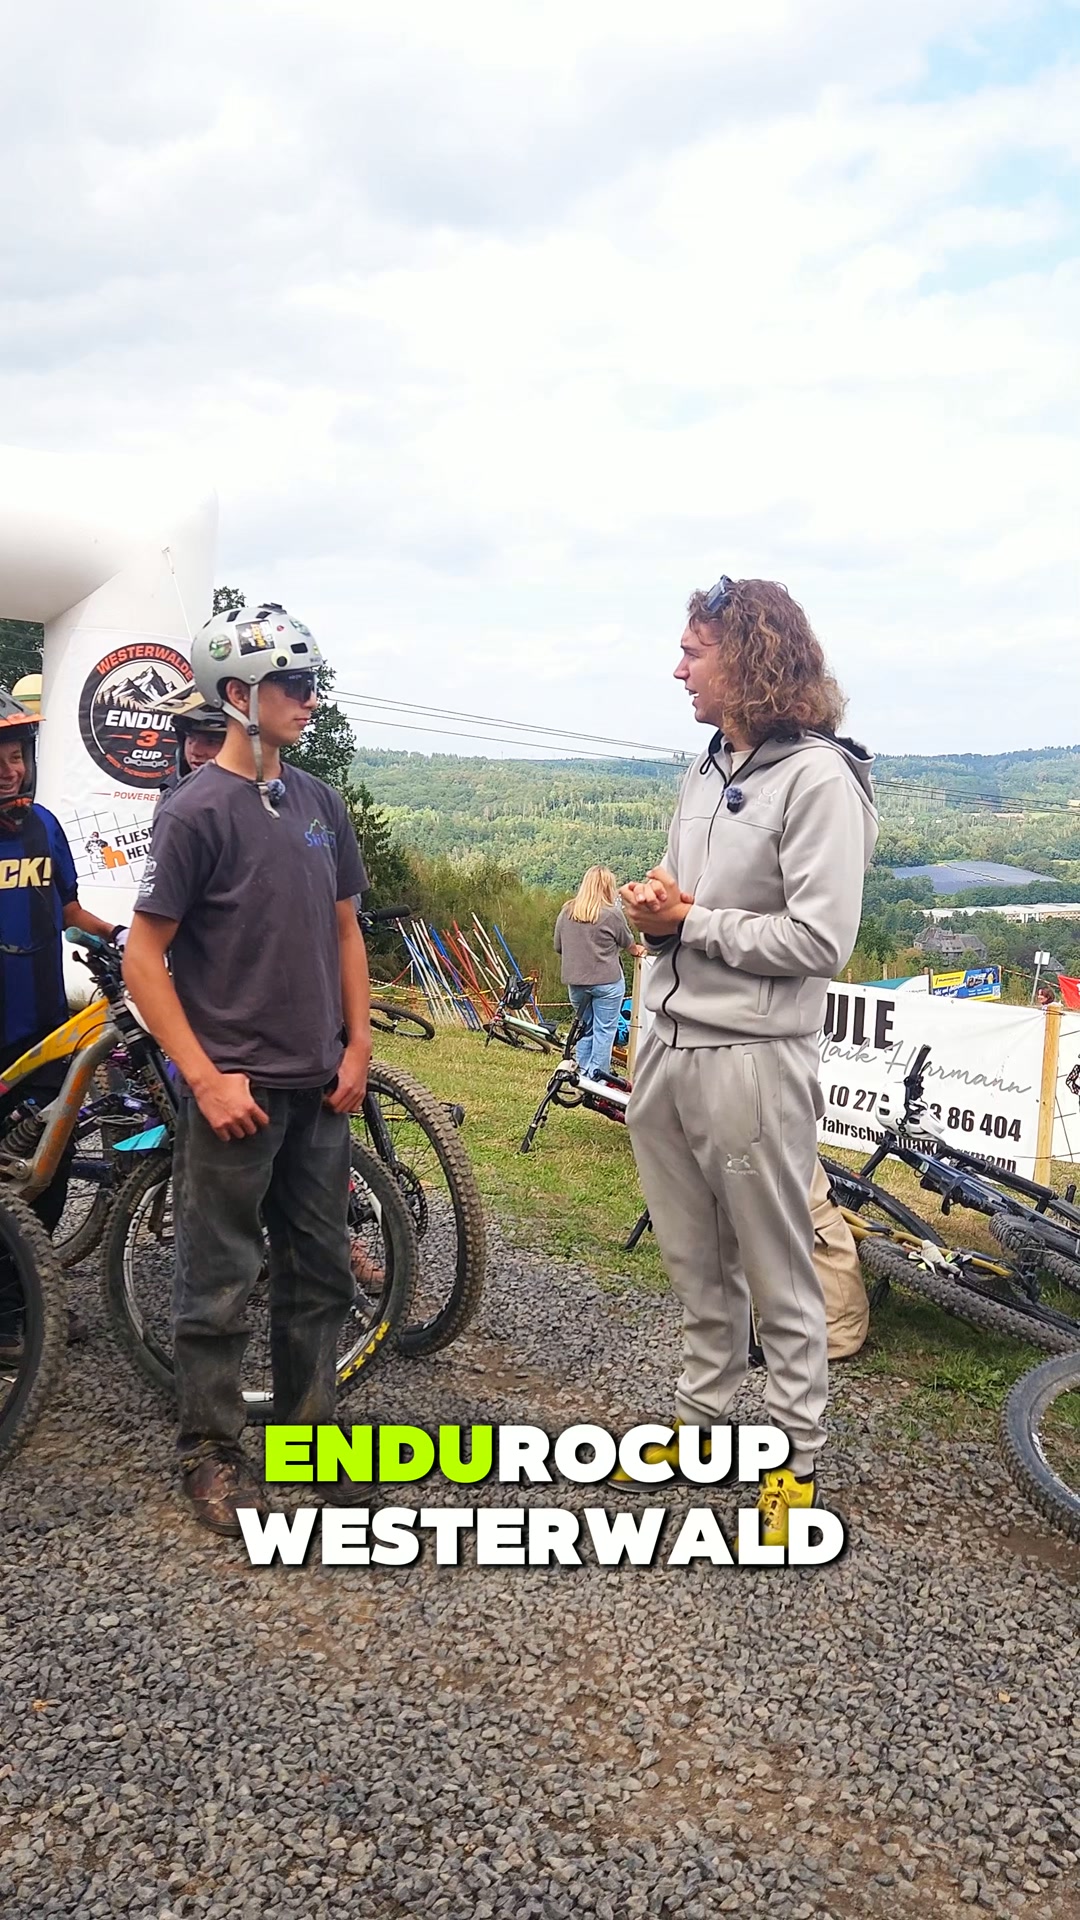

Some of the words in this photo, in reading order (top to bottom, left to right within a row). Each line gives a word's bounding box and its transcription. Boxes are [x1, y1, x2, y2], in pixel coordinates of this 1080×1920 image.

[131, 749, 163, 760] CUP
[136, 730, 160, 747] 3
[0, 856, 52, 889] CK!
[884, 1040, 1032, 1094] Hrrmann
[947, 1106, 975, 1132] 86
[980, 1113, 1021, 1142] 404
